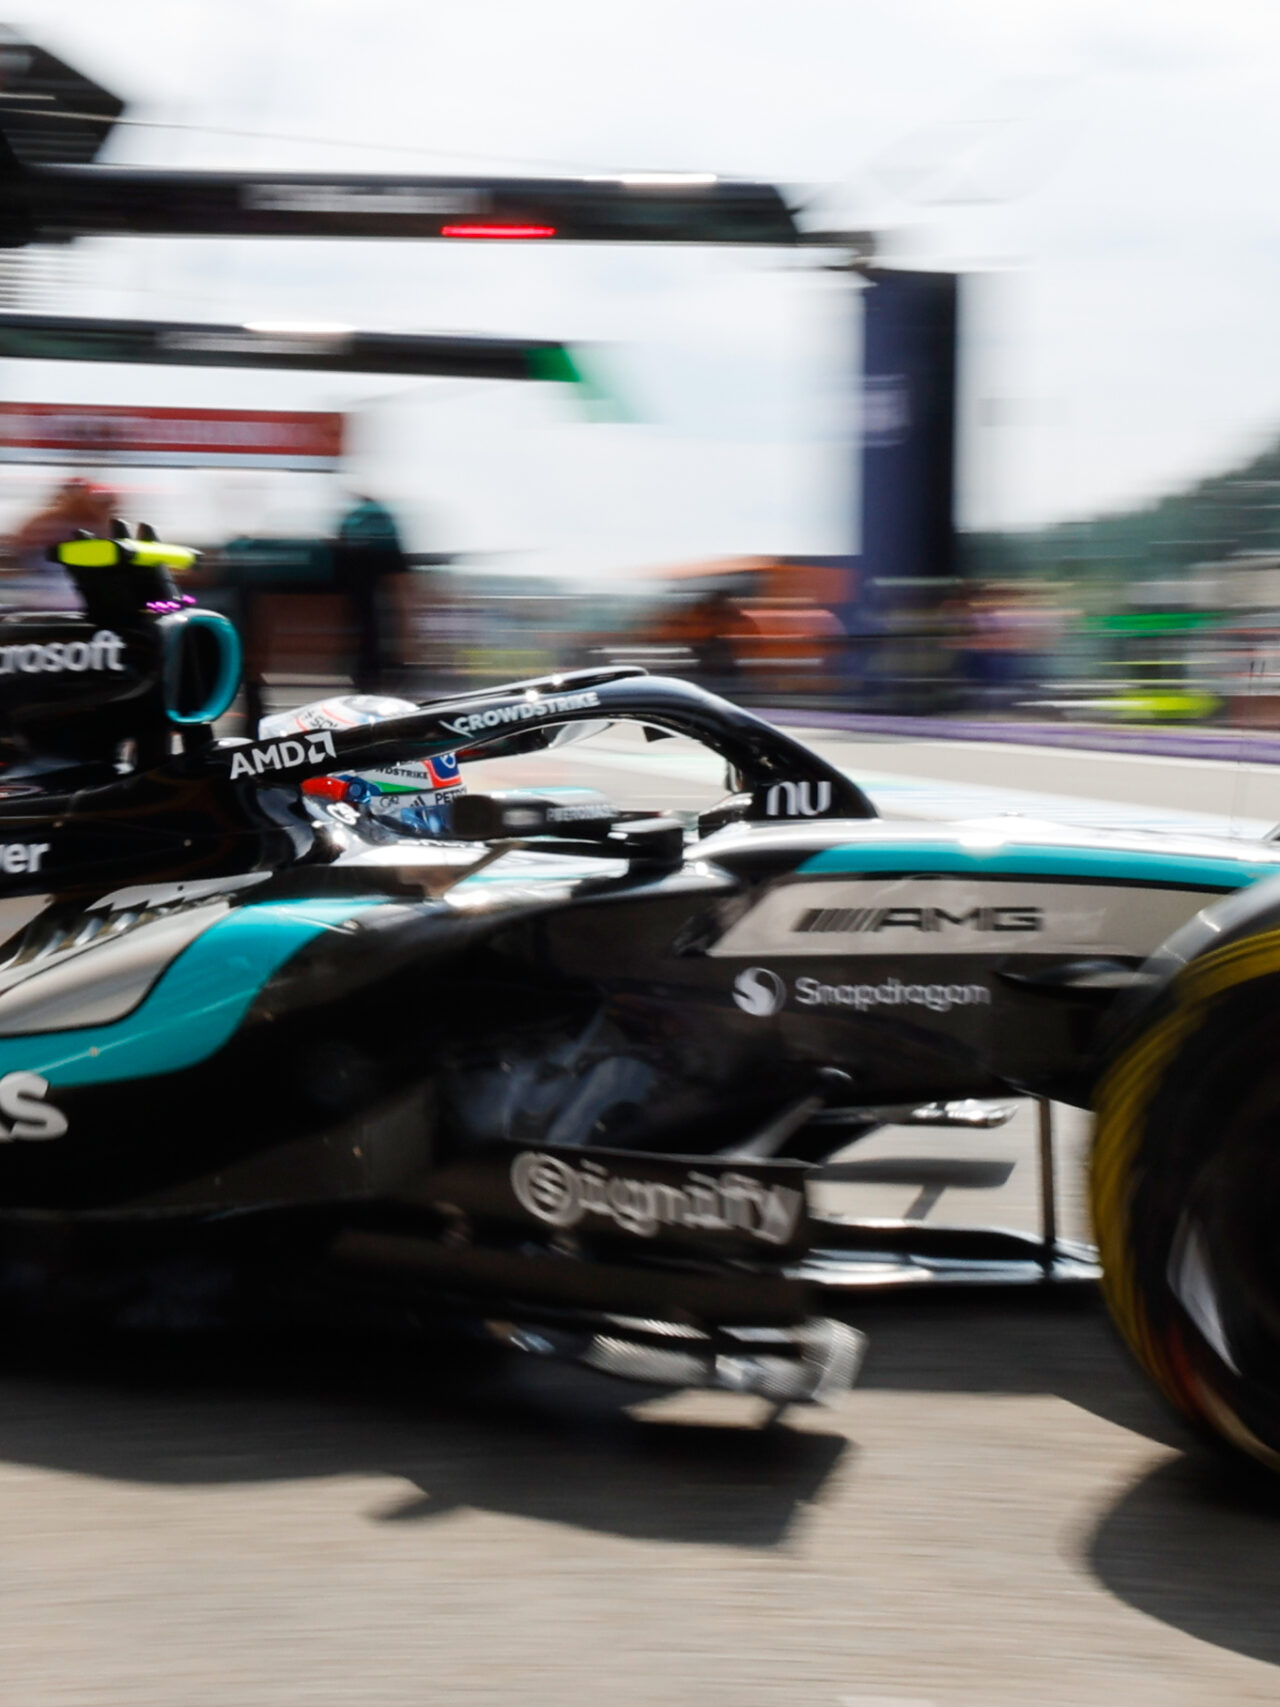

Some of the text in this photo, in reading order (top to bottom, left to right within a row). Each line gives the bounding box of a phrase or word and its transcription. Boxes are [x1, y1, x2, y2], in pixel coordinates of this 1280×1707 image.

[453, 691, 601, 733] CROWDSTRIKE
[230, 740, 305, 780] AMD
[0, 843, 50, 873] er
[795, 977, 992, 1012] Snapdragon
[0, 1070, 68, 1142] S
